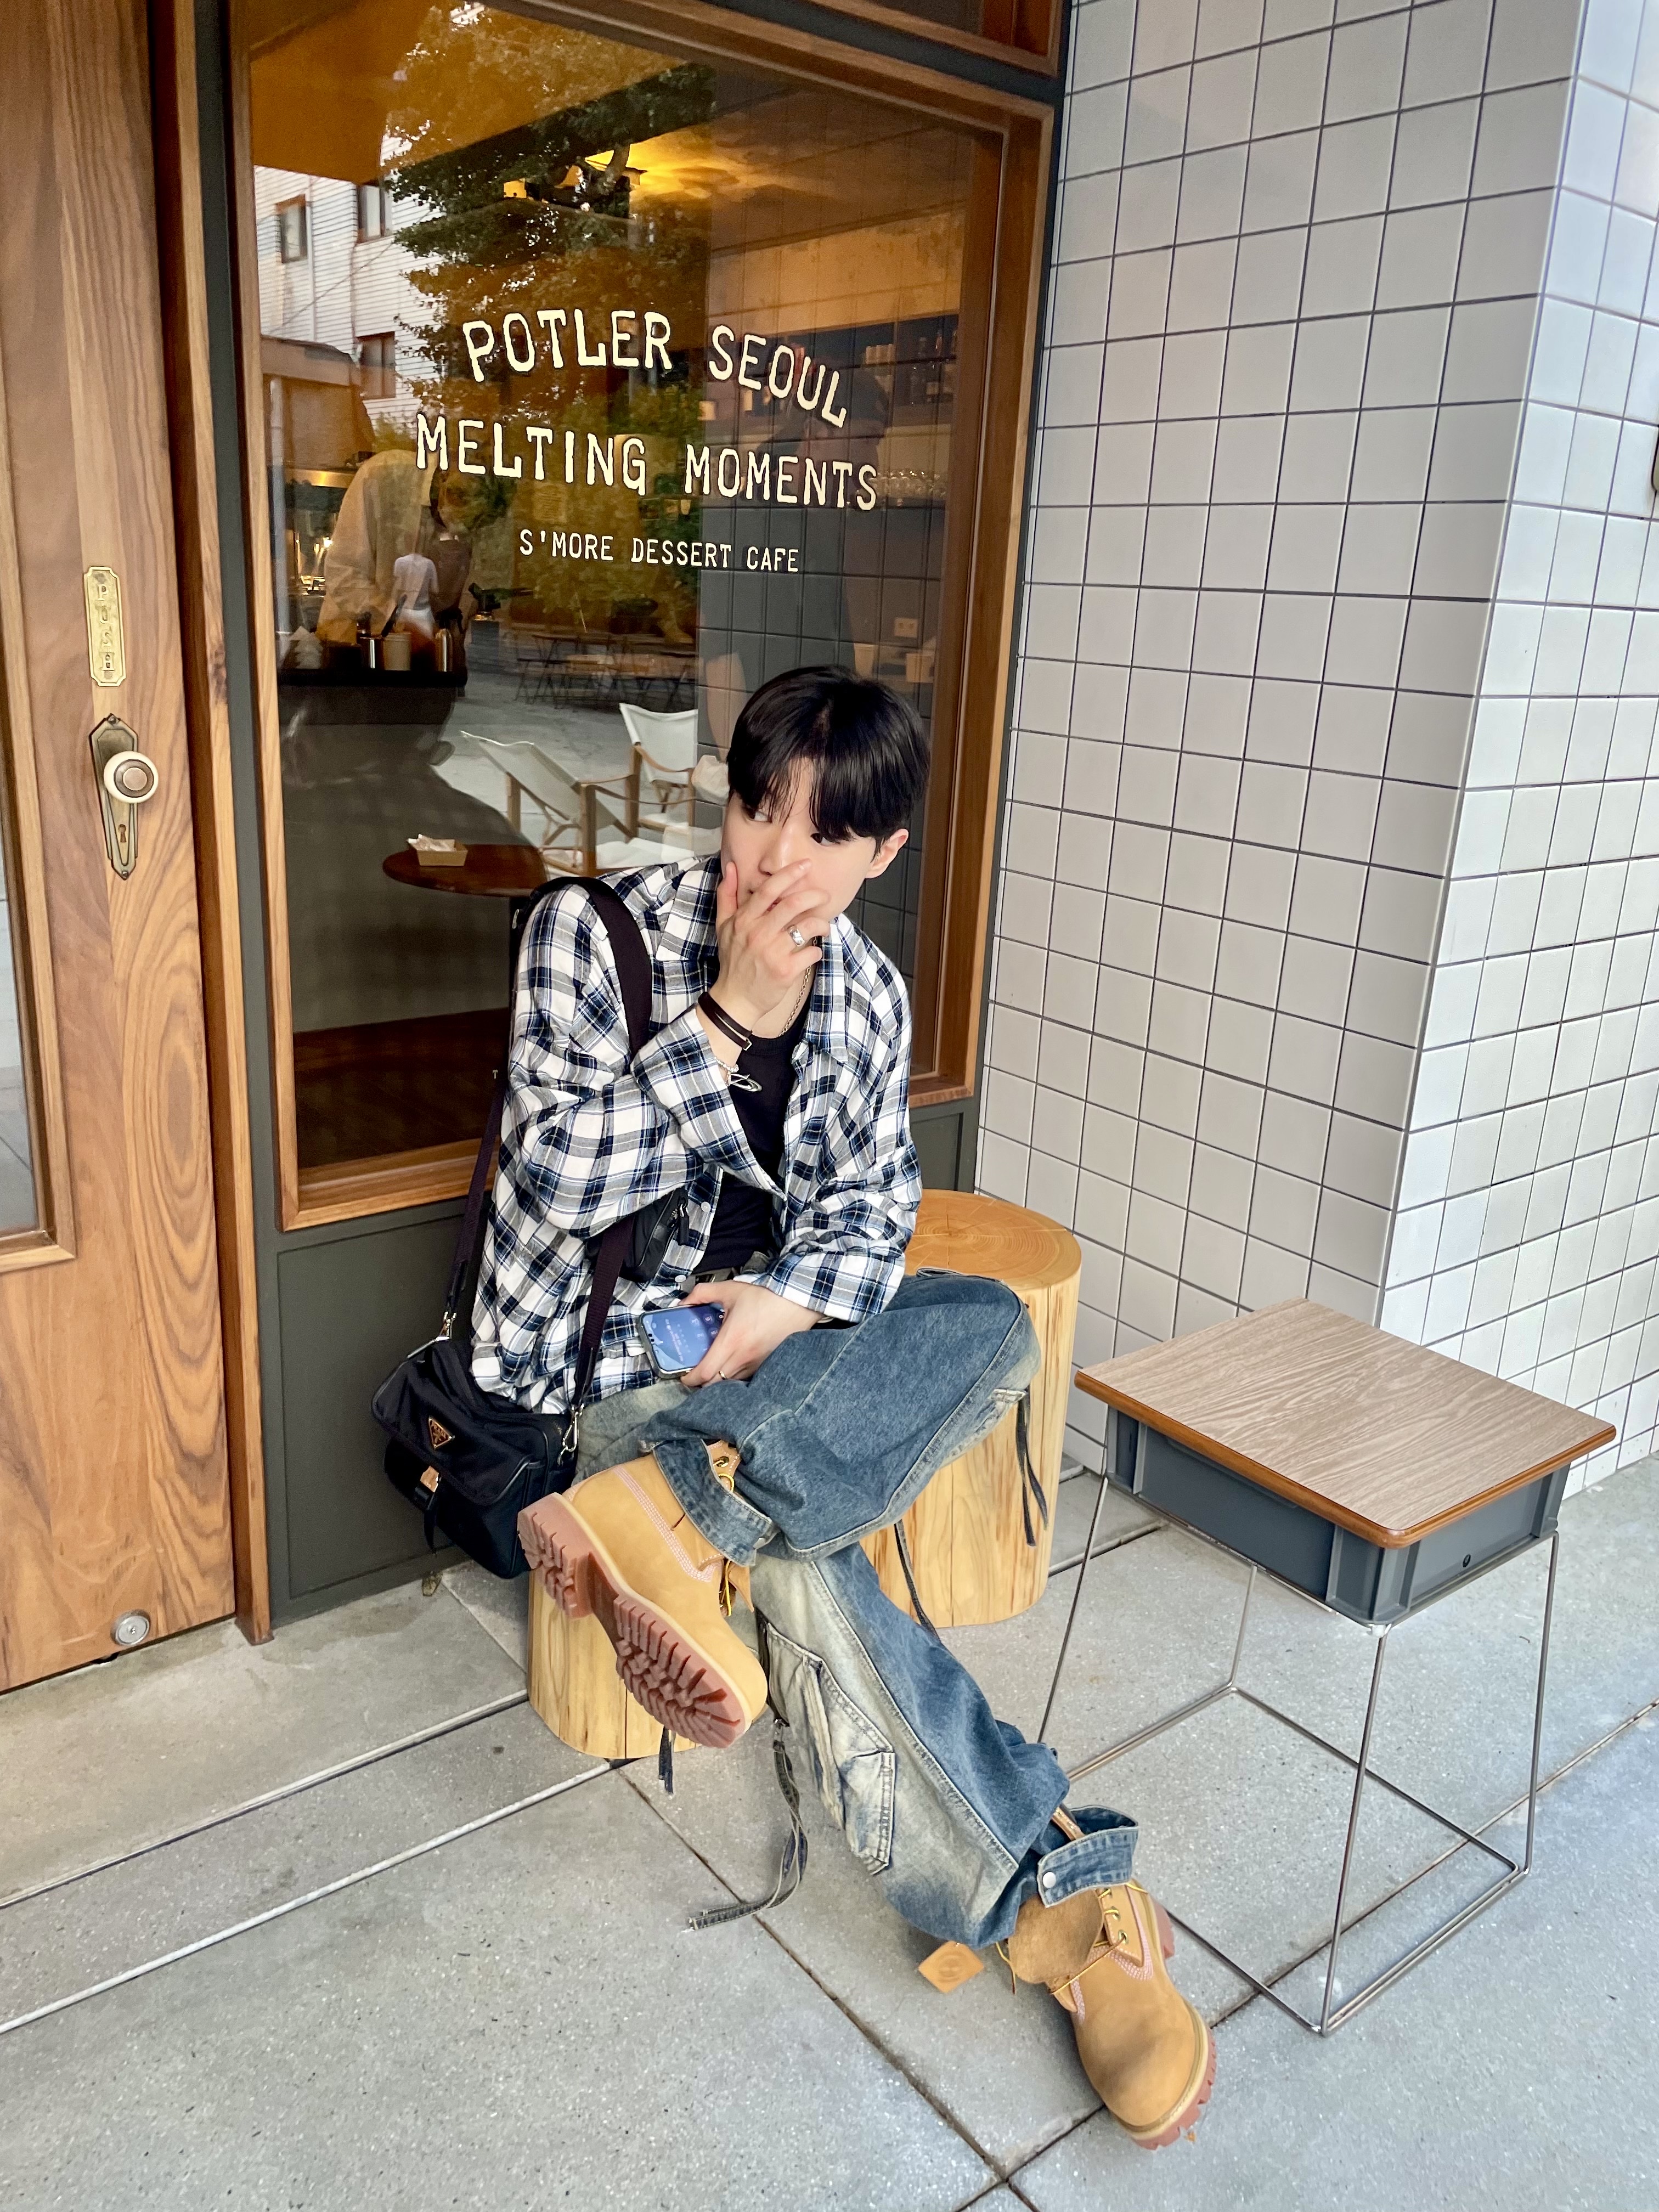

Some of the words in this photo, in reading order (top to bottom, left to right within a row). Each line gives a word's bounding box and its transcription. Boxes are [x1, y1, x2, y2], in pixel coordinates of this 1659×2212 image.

[462, 308, 672, 382] POTLER
[709, 325, 847, 428] SEOUL
[417, 414, 646, 496] MELTING
[685, 444, 876, 510] MOMENTS
[520, 529, 613, 561] S'MORE
[631, 538, 731, 568] DESSERT
[747, 546, 798, 572] CAFE
[95, 583, 115, 671] PUSH
